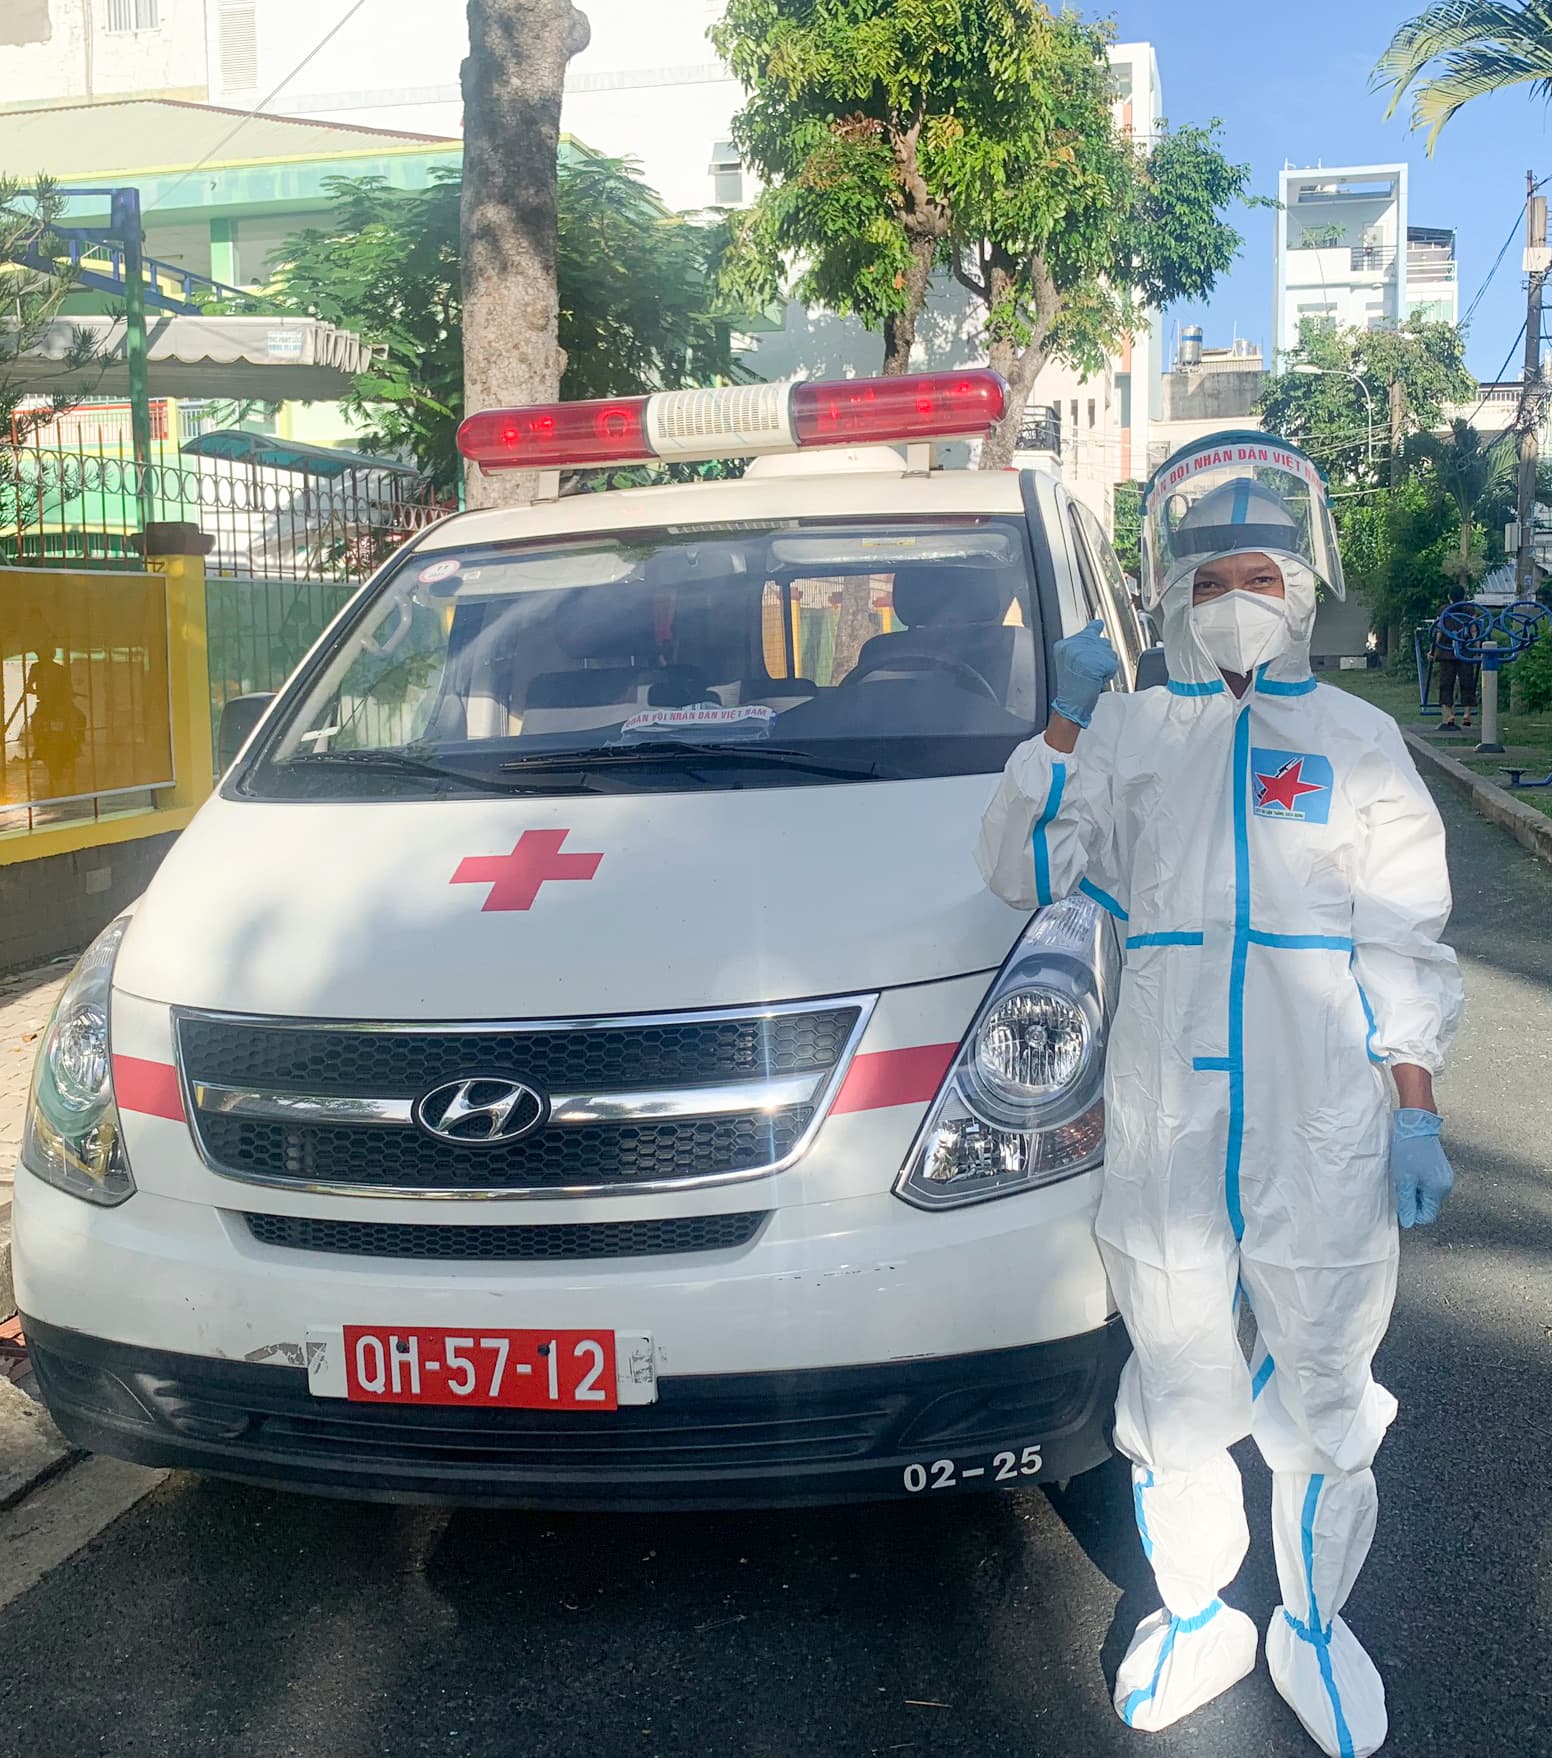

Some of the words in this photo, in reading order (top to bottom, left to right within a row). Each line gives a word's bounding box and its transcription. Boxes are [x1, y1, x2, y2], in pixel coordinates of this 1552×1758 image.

[1194, 449, 1232, 471] NHÂN
[1237, 446, 1268, 461] DÂN
[1272, 451, 1301, 472] VIỆT
[355, 1334, 606, 1401] QH-57-12
